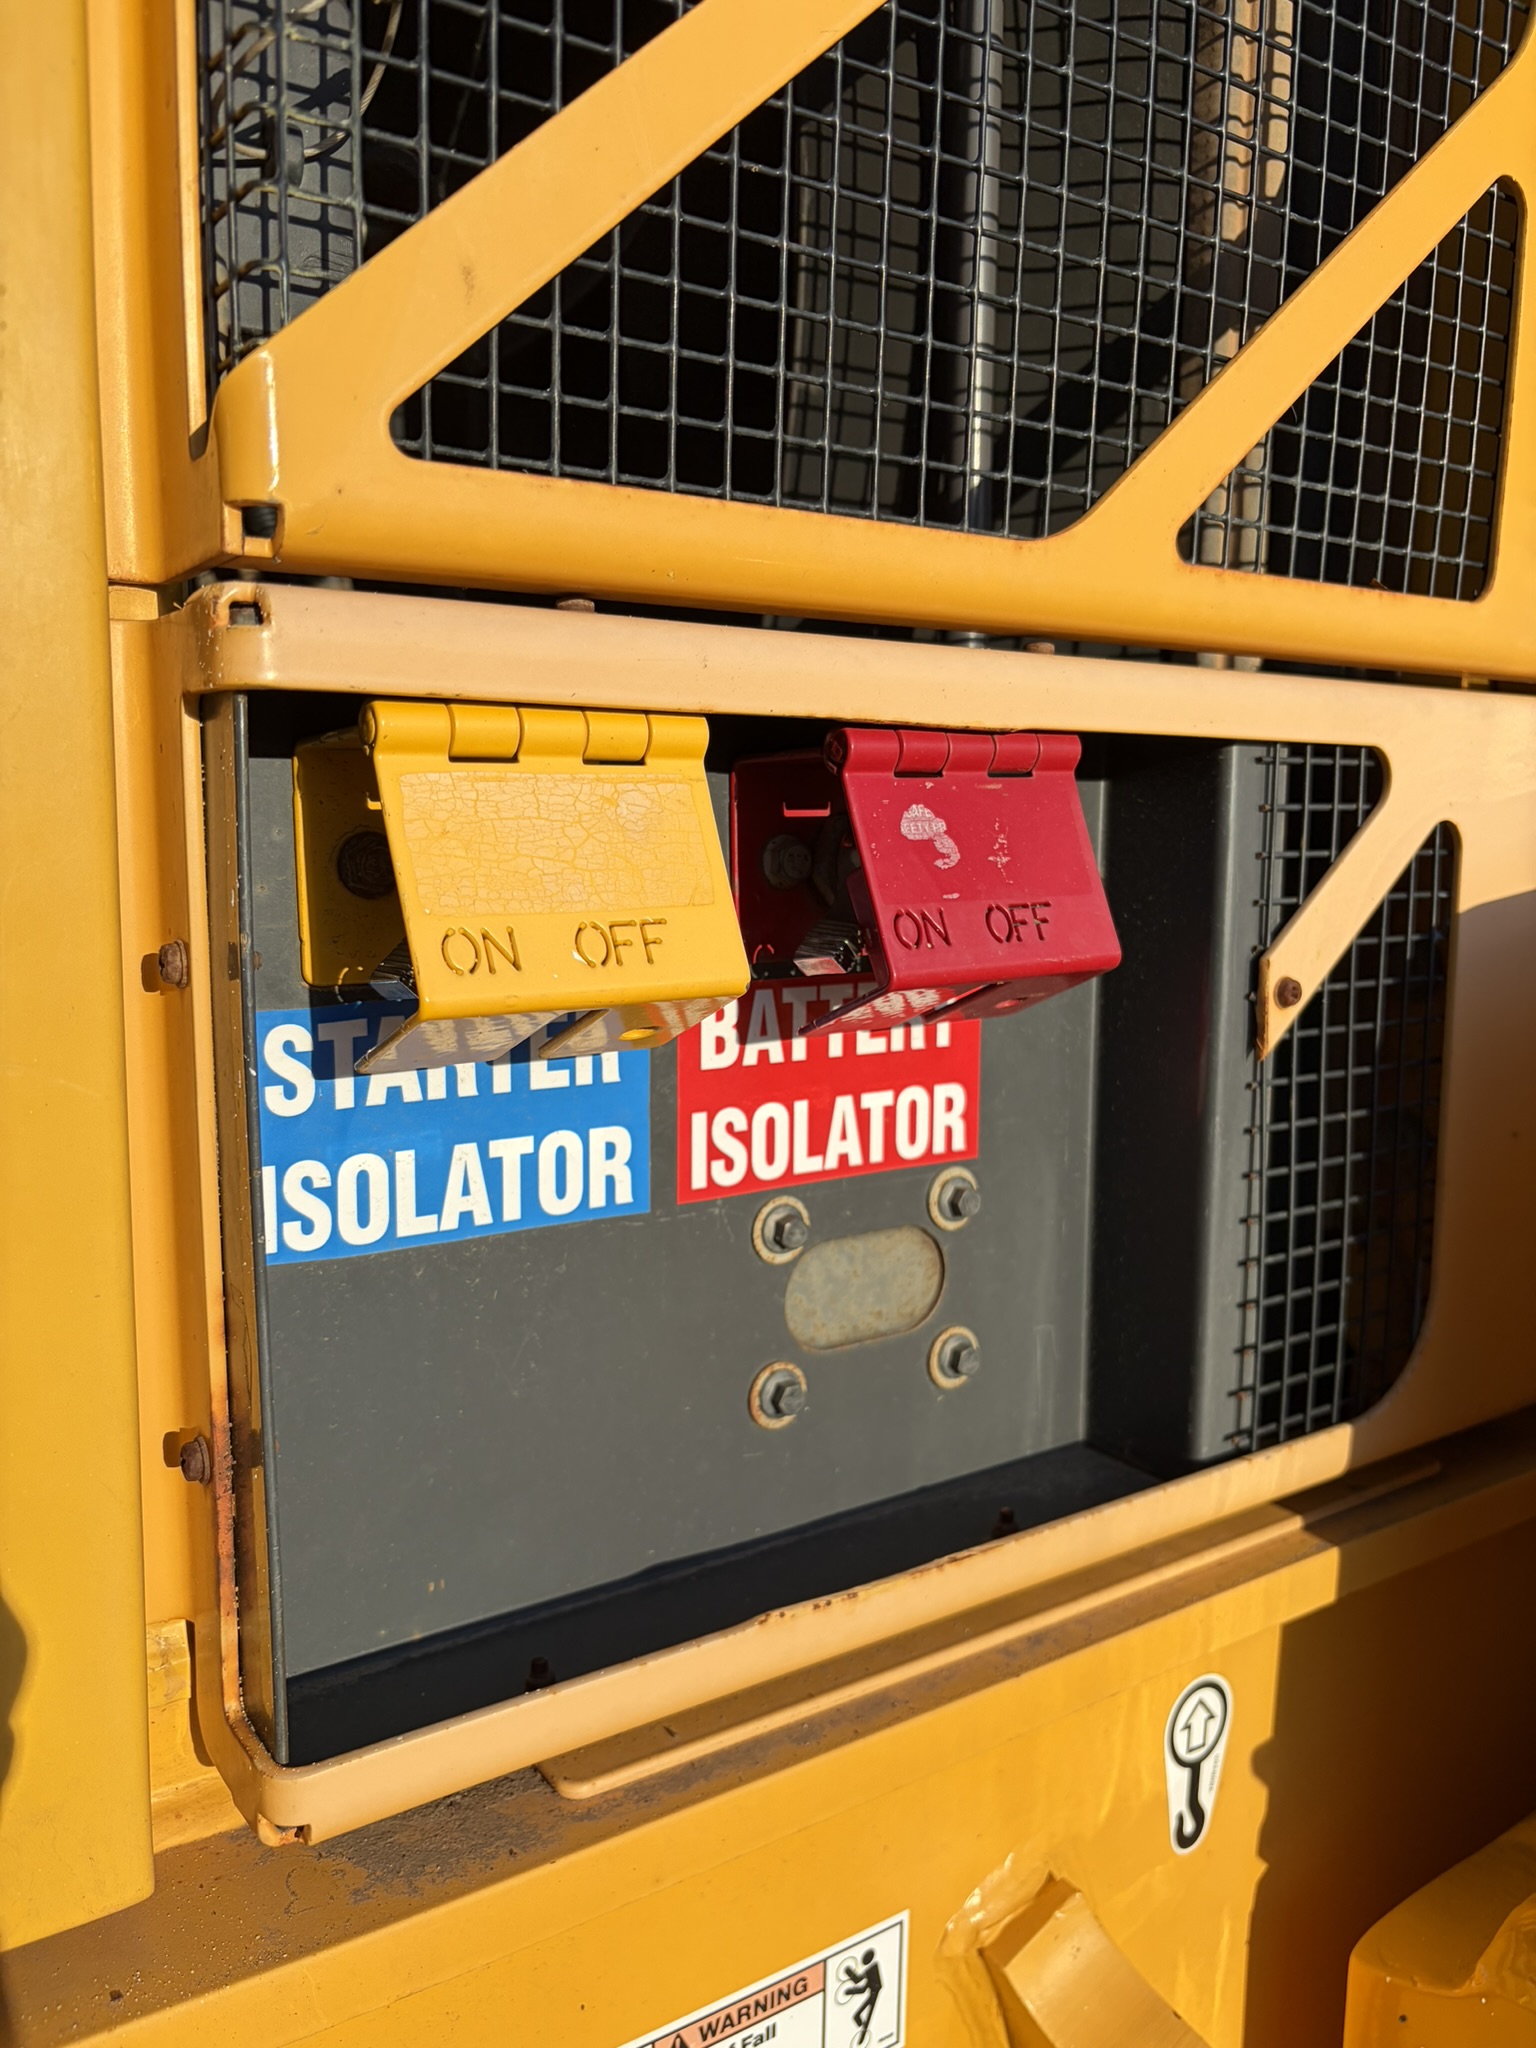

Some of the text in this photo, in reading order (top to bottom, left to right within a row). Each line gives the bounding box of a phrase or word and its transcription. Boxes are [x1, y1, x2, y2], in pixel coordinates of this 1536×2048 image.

[441, 918, 667, 976] ON OFF
[893, 901, 1052, 950] ON OFF
[700, 981, 951, 1071] BATT
[691, 1082, 968, 1190] ISOLATOR
[262, 1125, 634, 1254] ISOLATOR
[697, 1976, 808, 2042] WARNING
[740, 2022, 777, 2048] Fall
